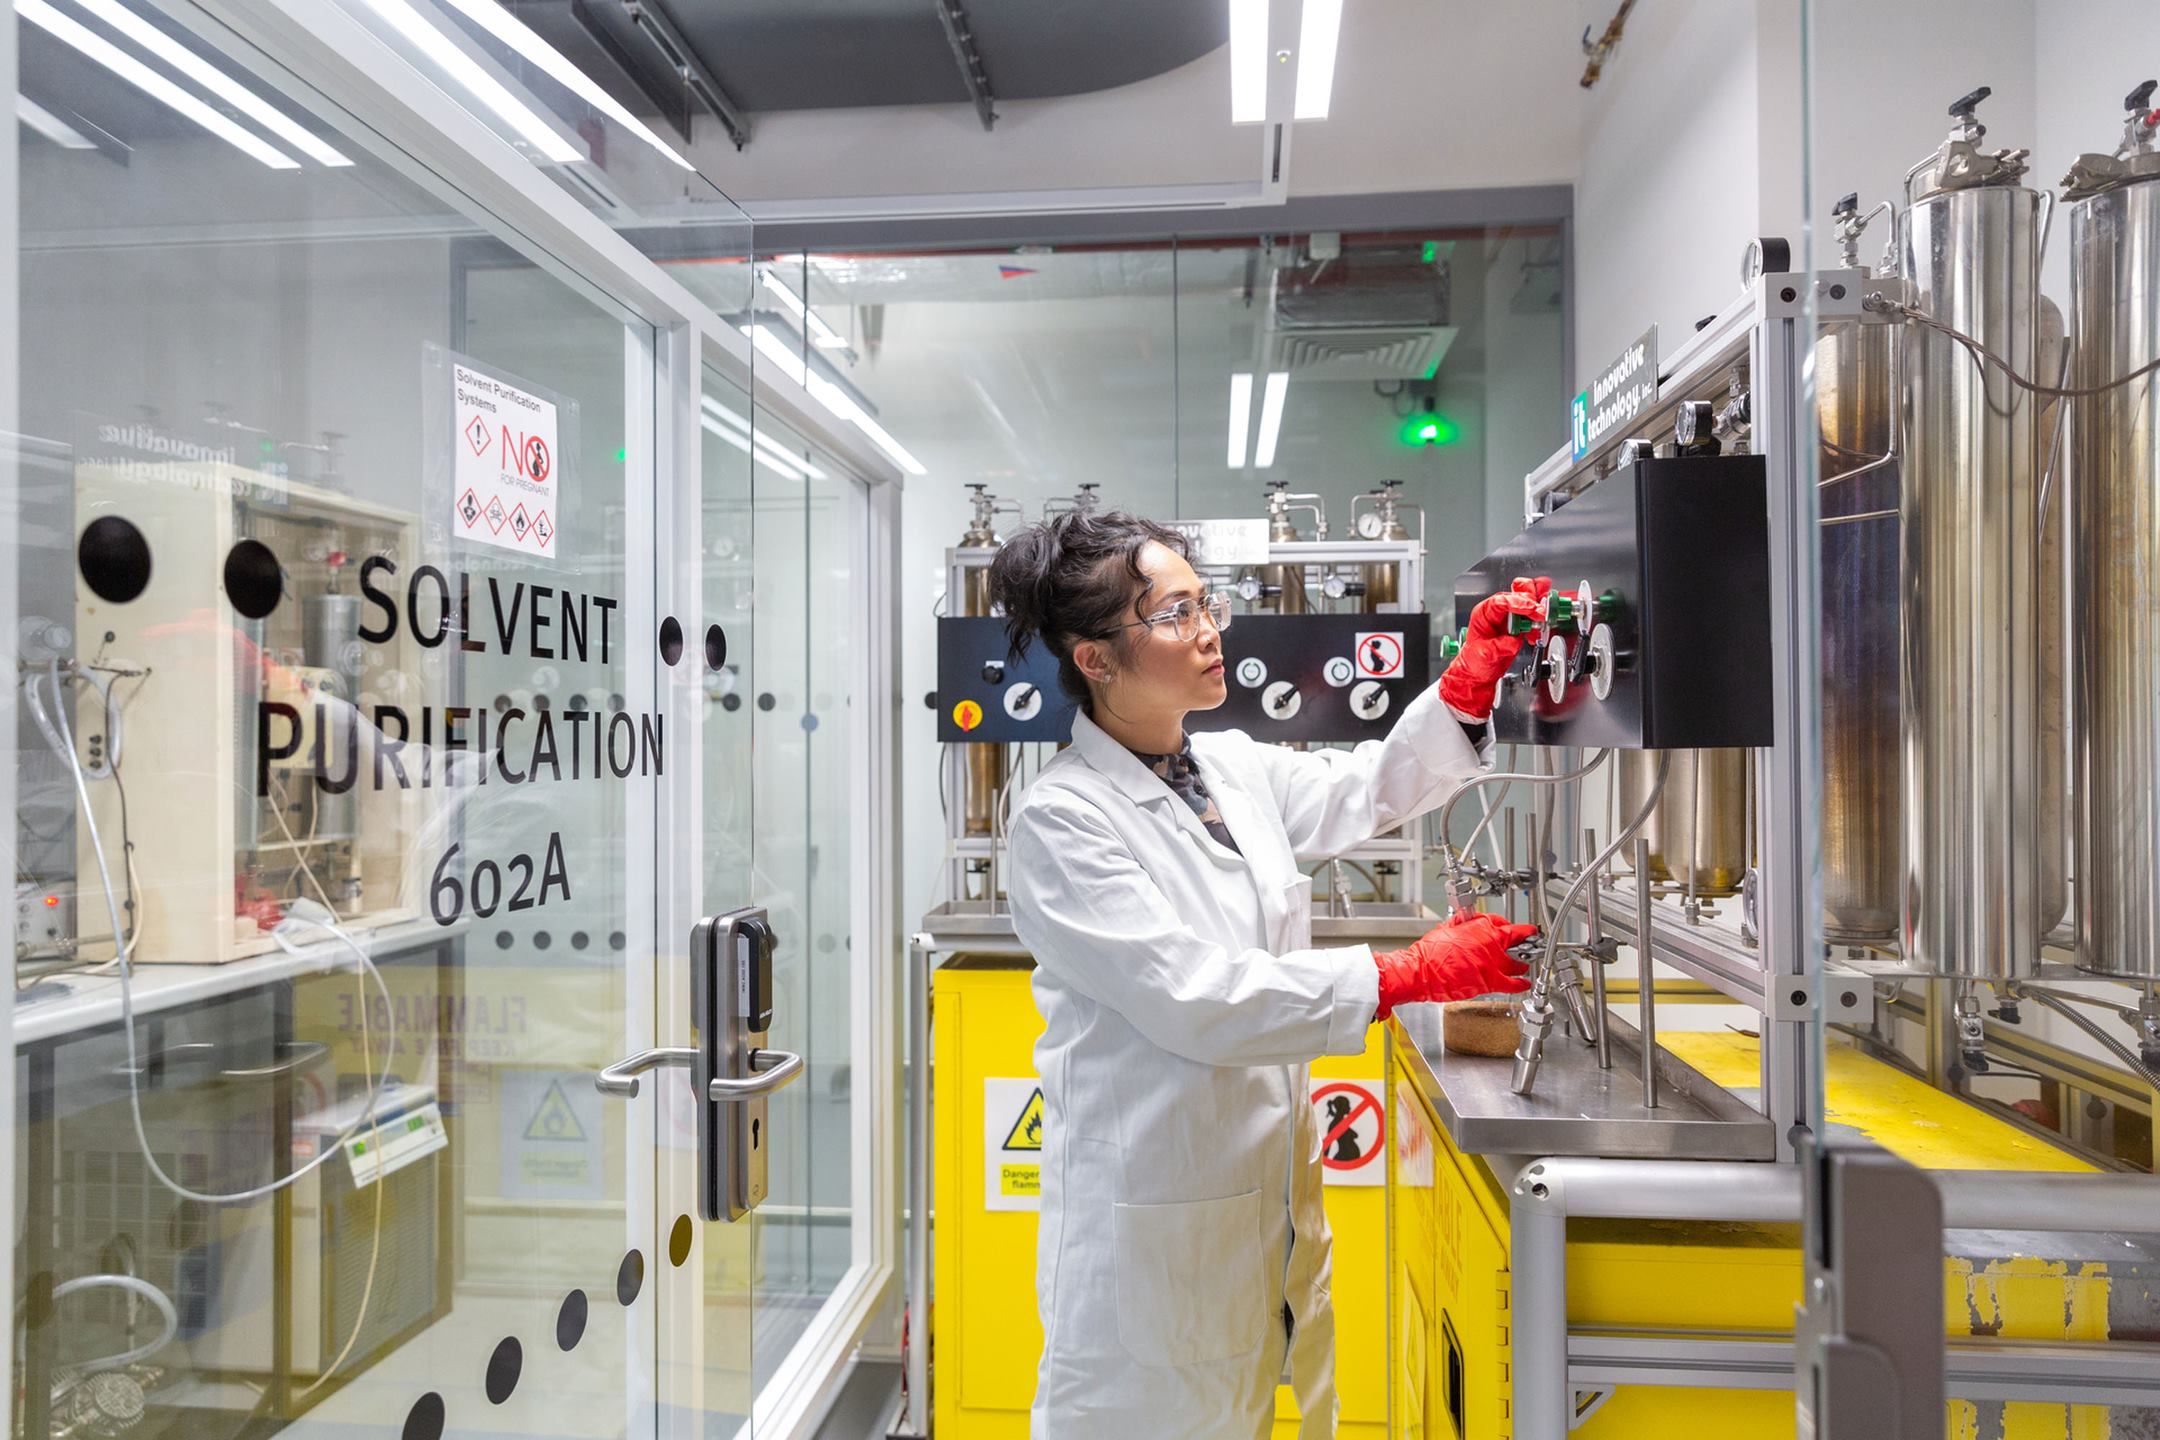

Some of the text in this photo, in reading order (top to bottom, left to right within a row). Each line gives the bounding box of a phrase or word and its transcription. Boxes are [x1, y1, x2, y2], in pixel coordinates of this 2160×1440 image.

[457, 368, 541, 413] Solvent Purification
[457, 388, 498, 414] Systems
[1593, 343, 1644, 407] innovative
[1573, 401, 1585, 455] it
[500, 473, 550, 497] FOR PREGNANT
[357, 555, 618, 665] SOLVENT
[257, 701, 663, 797] PURIFICATION
[430, 831, 571, 926] 602A
[1003, 1168, 1040, 1181] Danger
